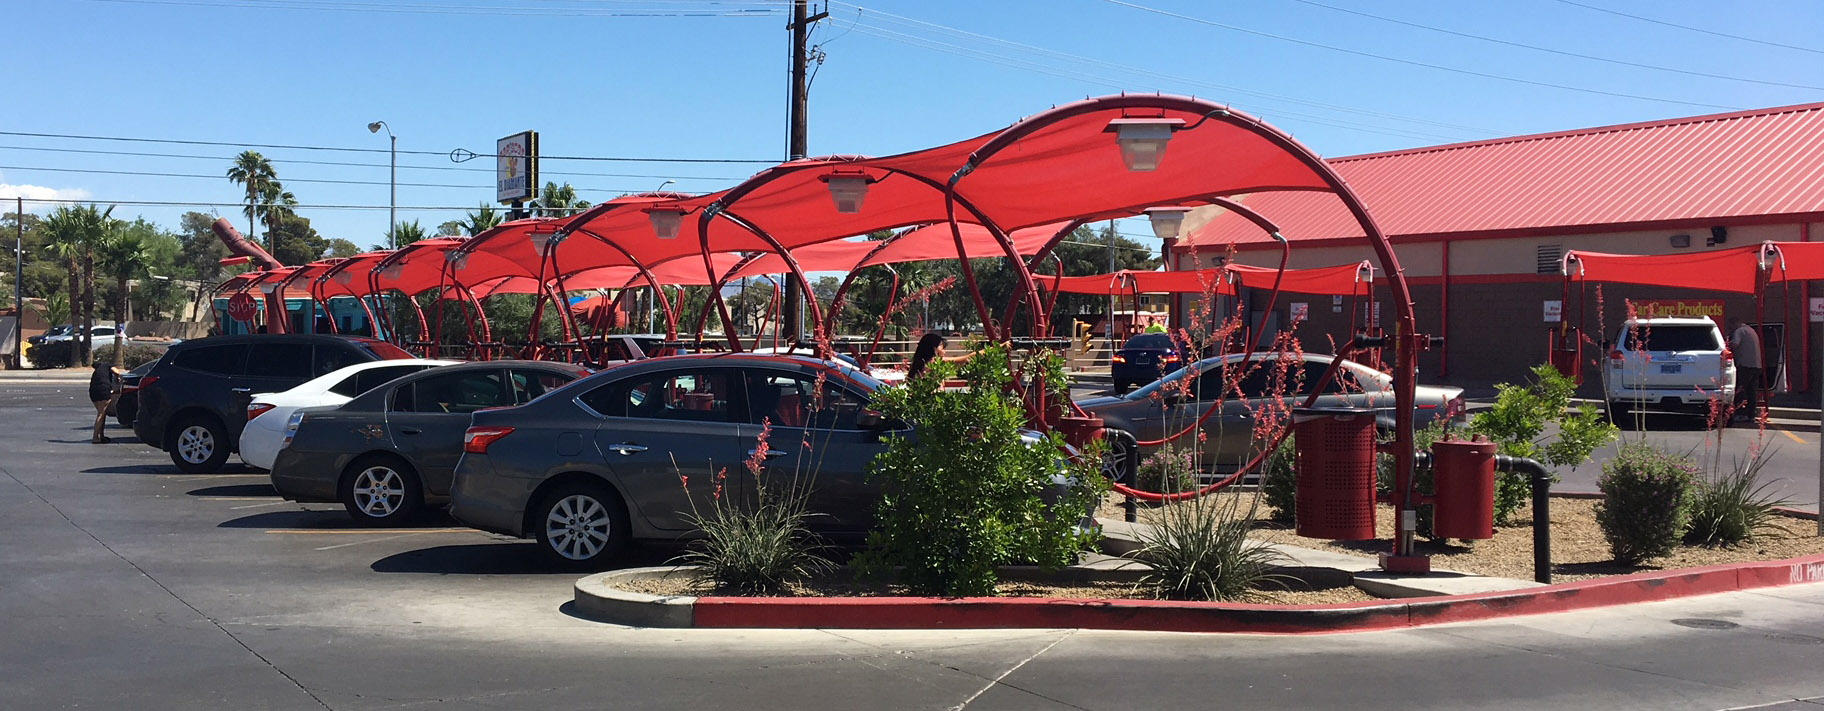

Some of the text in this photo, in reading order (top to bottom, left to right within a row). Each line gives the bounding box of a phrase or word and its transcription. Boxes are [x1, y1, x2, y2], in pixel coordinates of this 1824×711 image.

[229, 302, 256, 312] STOP
[1650, 301, 1675, 316] Care
[1677, 301, 1723, 316] Products
[1790, 563, 1803, 583] NO
